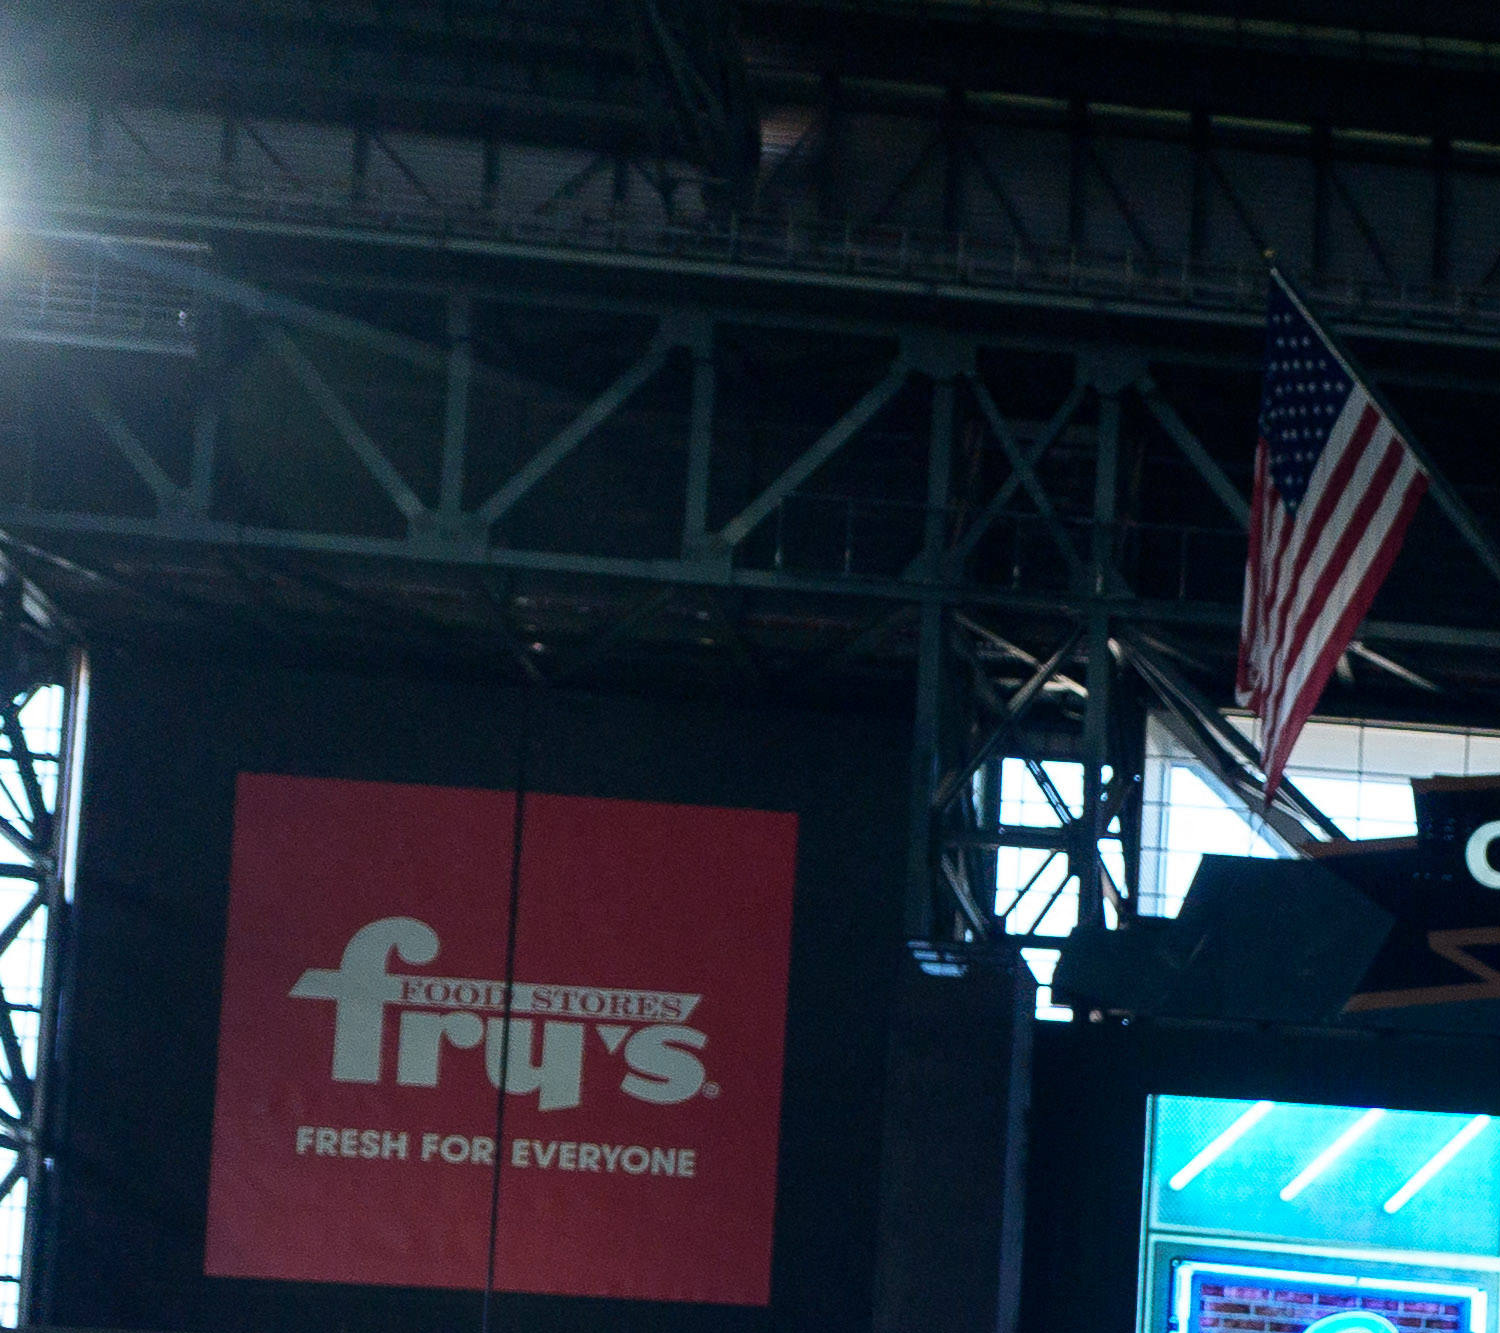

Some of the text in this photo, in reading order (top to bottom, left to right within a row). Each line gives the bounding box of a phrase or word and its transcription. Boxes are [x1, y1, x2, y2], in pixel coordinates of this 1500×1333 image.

[289, 916, 709, 1111] fry's
[402, 980, 684, 1020] FOOD STORES
[296, 1125, 697, 1178] FRESH FOR EVERYONE
